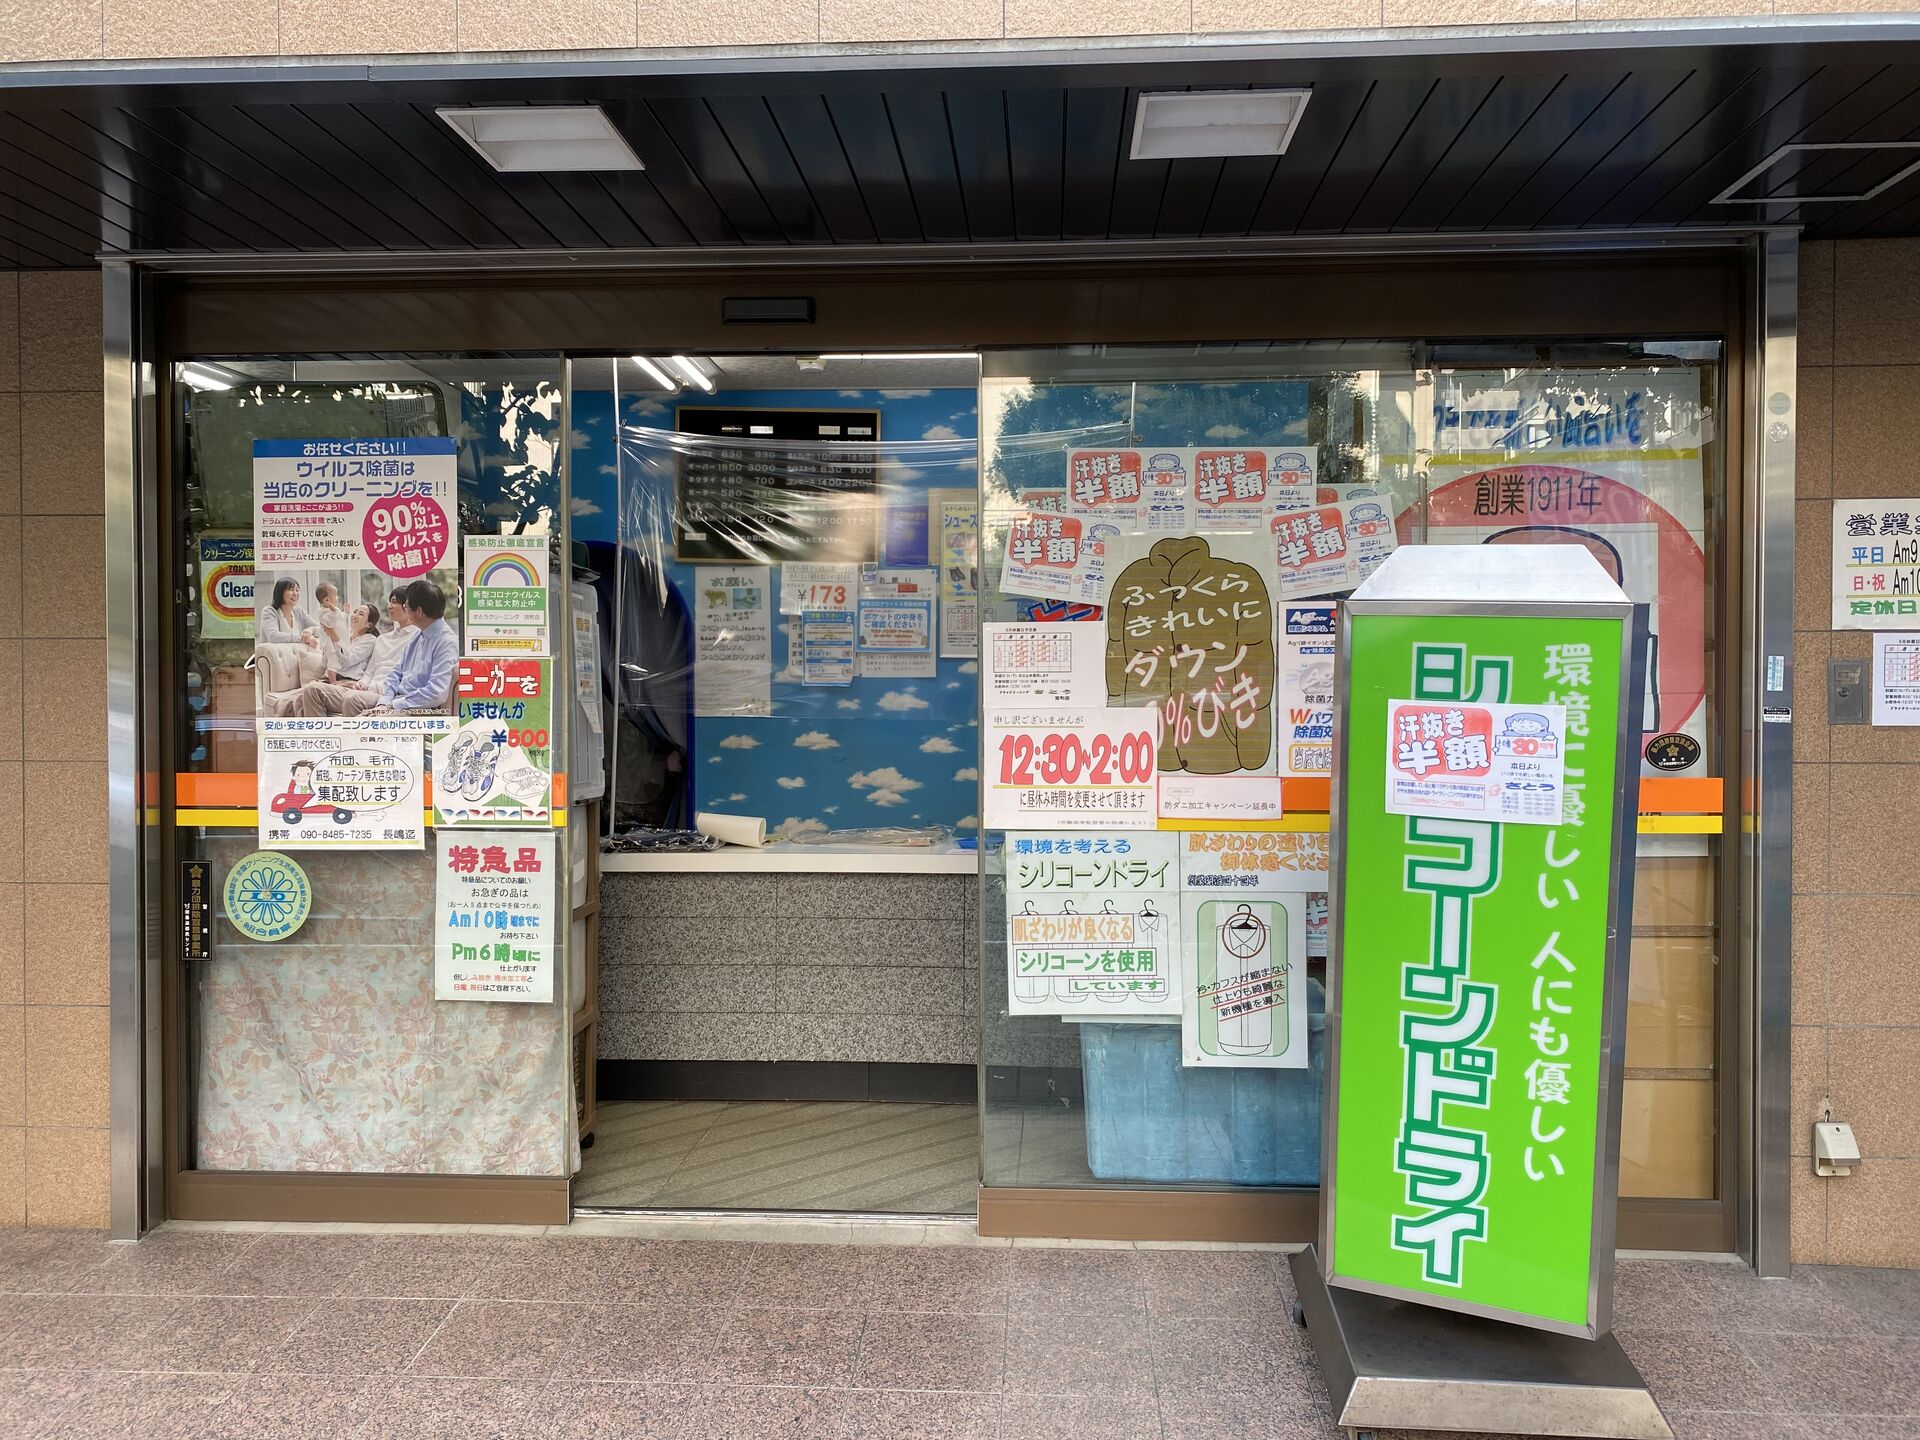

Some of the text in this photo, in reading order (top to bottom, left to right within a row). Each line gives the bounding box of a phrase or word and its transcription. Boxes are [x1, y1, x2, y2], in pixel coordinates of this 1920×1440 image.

[303, 442, 407, 456] お任せください!!
[296, 460, 415, 478] ウイルス除菌は
[1075, 453, 1121, 479] 汗抜き
[1199, 452, 1247, 479] 汗抜き
[263, 481, 448, 499] 当店のクリーニングを!!
[1075, 471, 1140, 503] 半額
[1198, 470, 1265, 504] 半額
[1473, 473, 1602, 516] 創業1911年
[262, 517, 345, 525] ドラム式大型洗濯機で洗い
[414, 514, 442, 530] 以上
[1015, 518, 1063, 539] 汗抜き
[1275, 512, 1322, 545] 汗抜き
[1846, 512, 1920, 536] 営業
[261, 530, 334, 538] 乾燥も天日干しではなく
[373, 531, 443, 553] ウイルスを
[468, 538, 544, 548] 感染防止徹底宣言
[204, 547, 254, 559] クリーニング保
[1013, 537, 1077, 565] 半額
[1279, 526, 1346, 567] 半額
[1852, 547, 1884, 565] 平日
[387, 546, 438, 571] 除菌!!
[1121, 573, 1249, 606] ふっくら
[1854, 573, 1886, 591] 日・祝
[473, 591, 541, 599] 新型コロナウイルス
[1850, 600, 1917, 615] 定休日
[1126, 600, 1262, 637] きれいに
[1124, 640, 1248, 687] ダウン
[994, 715, 1083, 725] 申し訳ございませんが
[1399, 709, 1465, 742] 汗抜き
[492, 729, 549, 748] ¥500
[1397, 734, 1490, 775] 半額
[318, 785, 401, 802] 集配致します
[1505, 782, 1556, 791] さとう
[1019, 790, 1146, 809] に昼休み時間を変更させて頂きます
[1165, 801, 1277, 811] 防ダニ加工キャンペーン延長中
[268, 829, 290, 840] 携帯
[300, 829, 372, 839] 090-8485-7235
[1015, 838, 1131, 855] 環境を考える
[448, 845, 542, 874] 特急品
[1019, 860, 1170, 889] シリコーンドライ
[471, 888, 529, 898] お急ぎの品は
[500, 932, 538, 940] お持ち下さい
[1014, 916, 1133, 942] 肌ざわりが良くなる
[1020, 950, 1154, 973] シリコーンを使用
[1074, 981, 1163, 991] しています
[1212, 979, 1285, 1005] 仕上りも綺麗な
[1220, 993, 1285, 1017] 新機種を導入
[1524, 931, 1577, 1181] 人にも優しい
